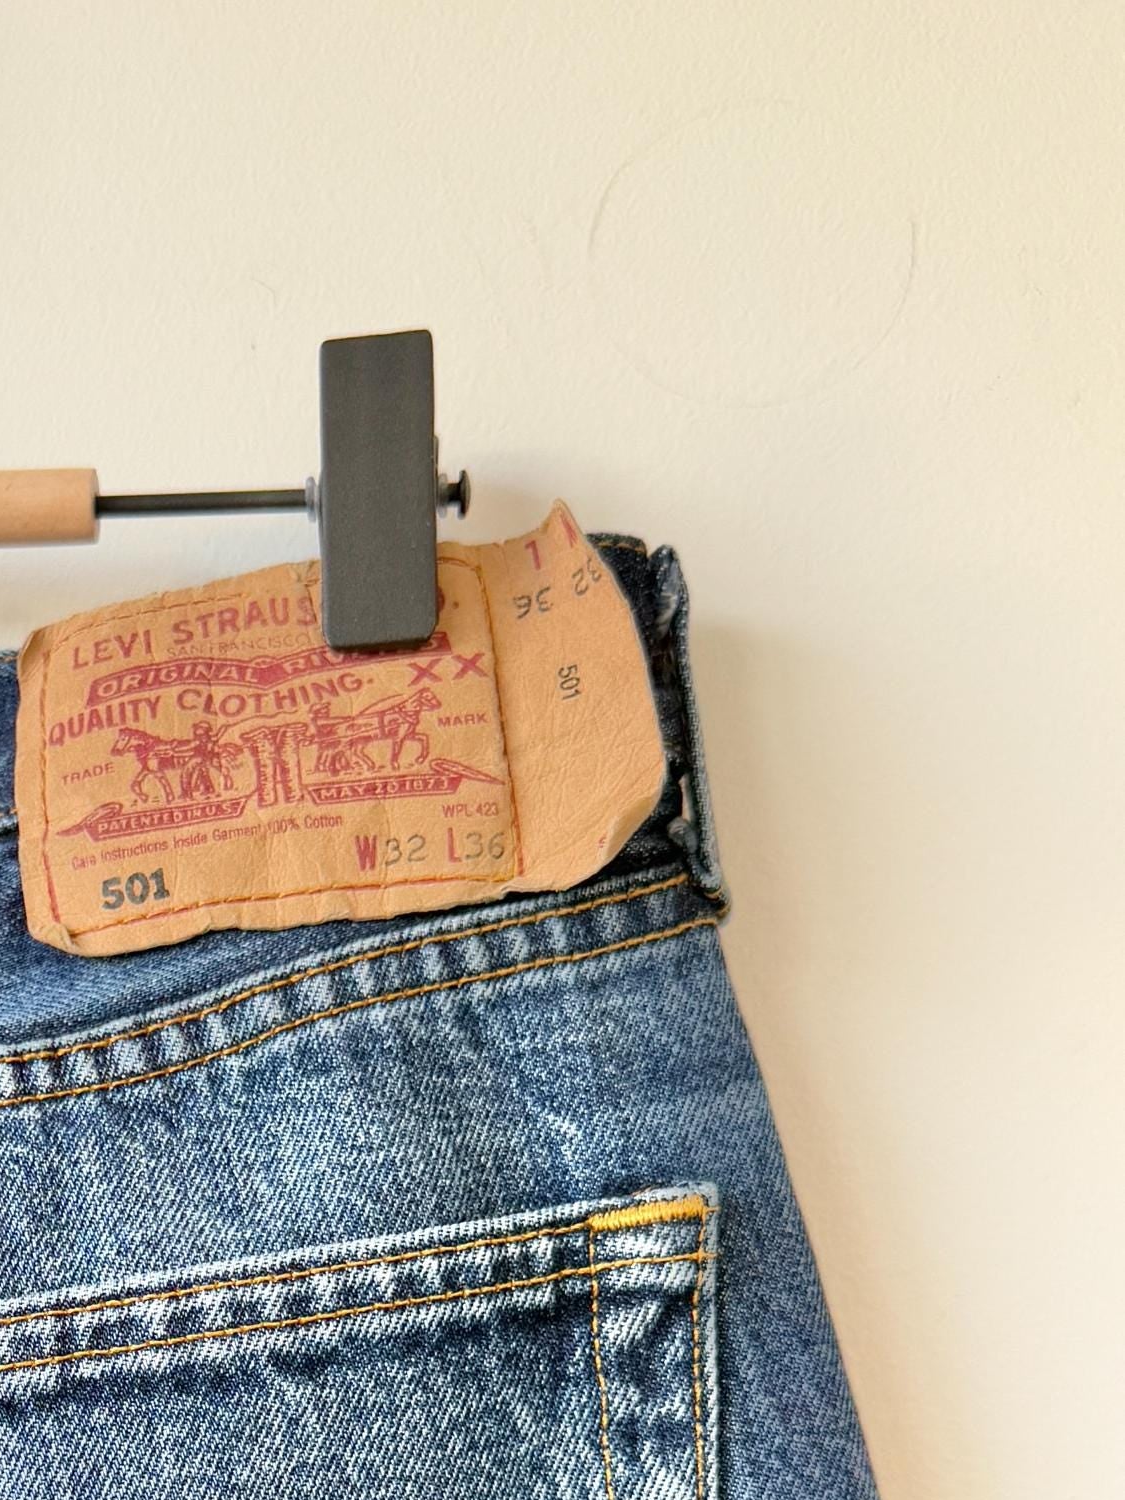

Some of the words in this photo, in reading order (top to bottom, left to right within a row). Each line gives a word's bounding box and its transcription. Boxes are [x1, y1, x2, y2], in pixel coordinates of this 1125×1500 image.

[513, 586, 554, 619] 36
[72, 629, 152, 670] LEVI
[172, 597, 316, 645] STRAUS
[97, 664, 259, 697] ORIGINAL
[557, 664, 582, 700] 501
[49, 696, 160, 746] QUALITY
[438, 712, 489, 728] MARK
[62, 762, 115, 786] TRADE
[320, 784, 366, 800] MAY
[375, 781, 400, 794] 20
[405, 777, 449, 791] 1873
[98, 812, 183, 833] PATENTED
[442, 804, 472, 818] WPL
[474, 802, 499, 816] 423
[71, 855, 97, 871] Care
[101, 841, 169, 864] Instructions
[173, 831, 209, 849] Inside
[212, 823, 261, 842] Garment
[304, 814, 343, 830] Cotton
[101, 867, 171, 911] 501
